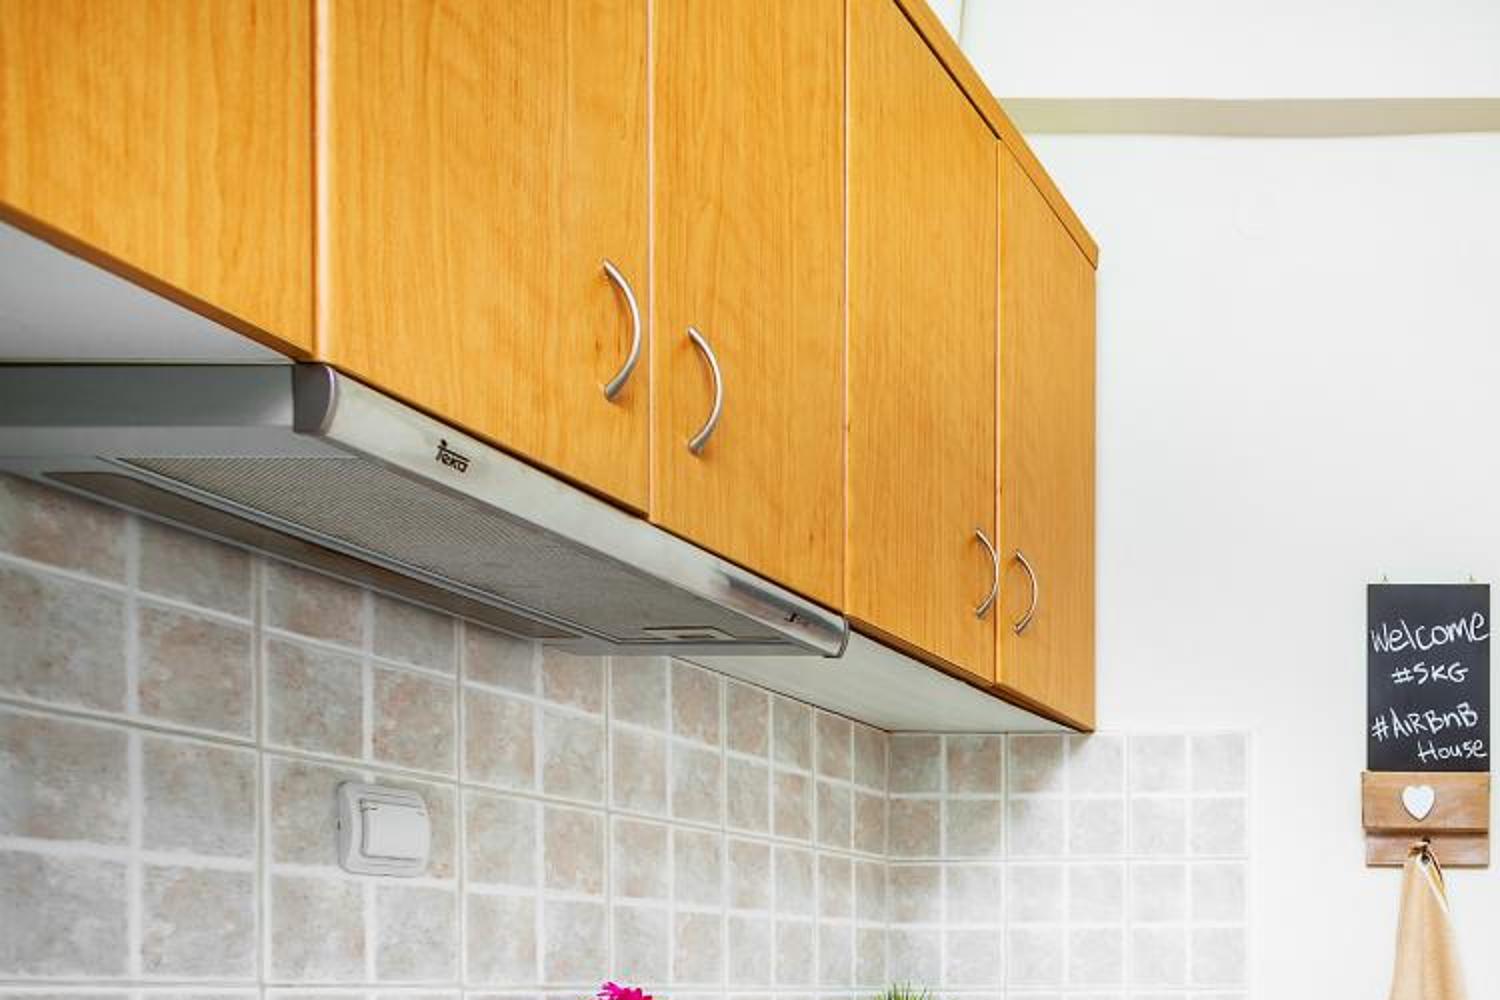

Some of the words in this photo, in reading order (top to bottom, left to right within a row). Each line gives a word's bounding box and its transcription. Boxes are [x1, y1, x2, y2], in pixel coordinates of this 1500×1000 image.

[1371, 612, 1489, 652] Welcome
[1391, 661, 1469, 684] #SKG
[1417, 739, 1488, 763] House
